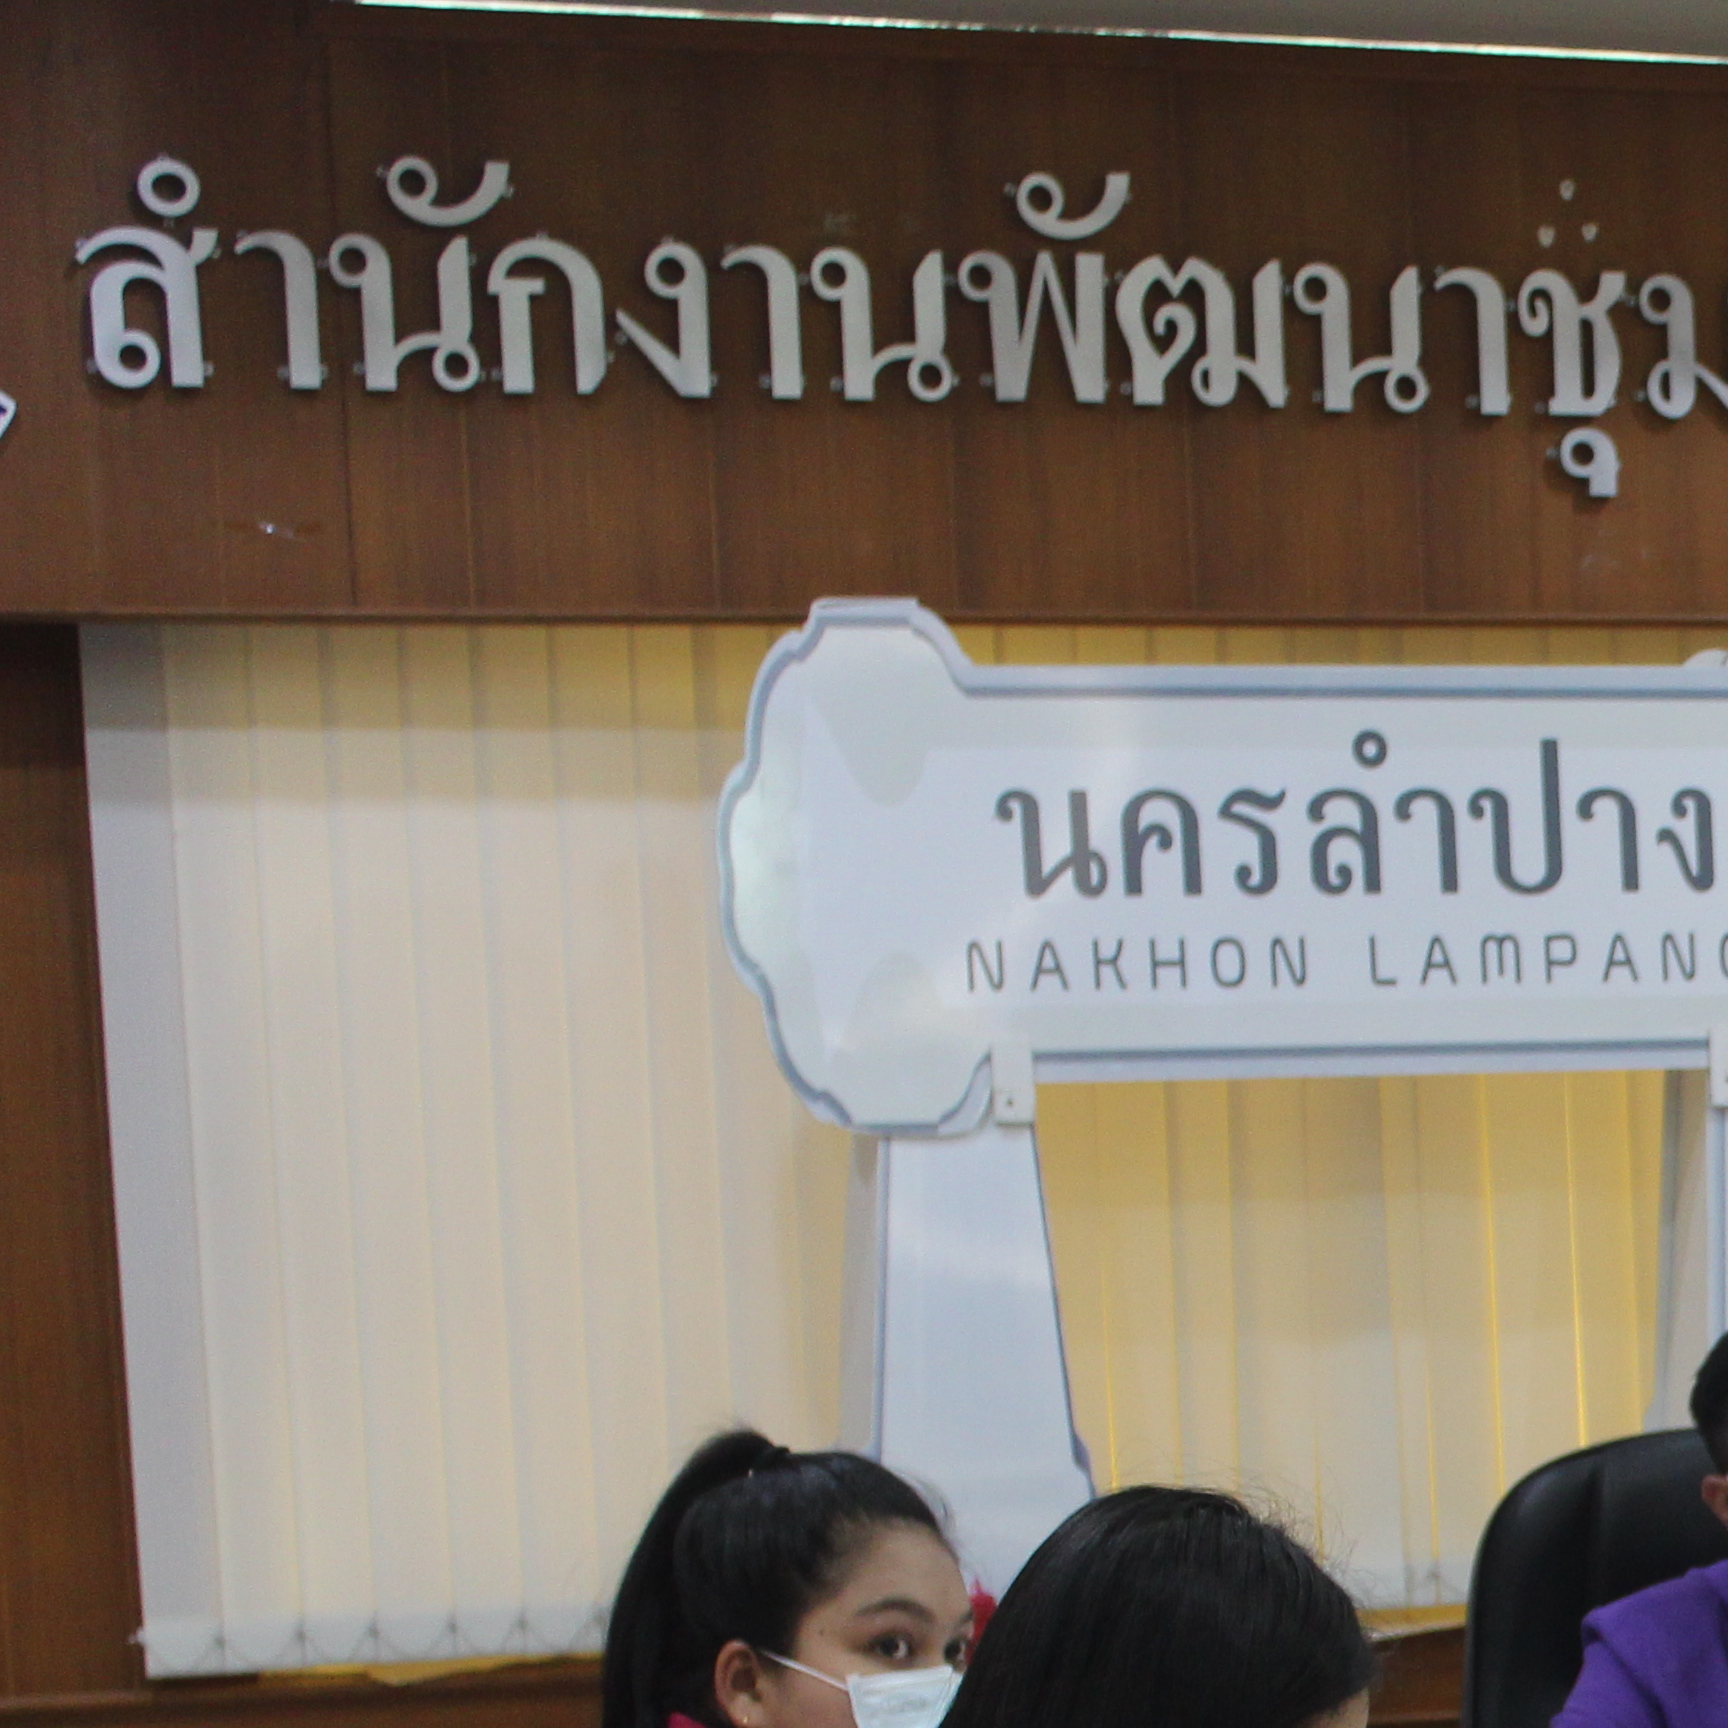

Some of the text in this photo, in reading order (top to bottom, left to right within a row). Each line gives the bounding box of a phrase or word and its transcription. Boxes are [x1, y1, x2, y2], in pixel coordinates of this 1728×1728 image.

[993, 727, 1716, 898] นครลำปาง
[965, 935, 1309, 992] NAKHON
